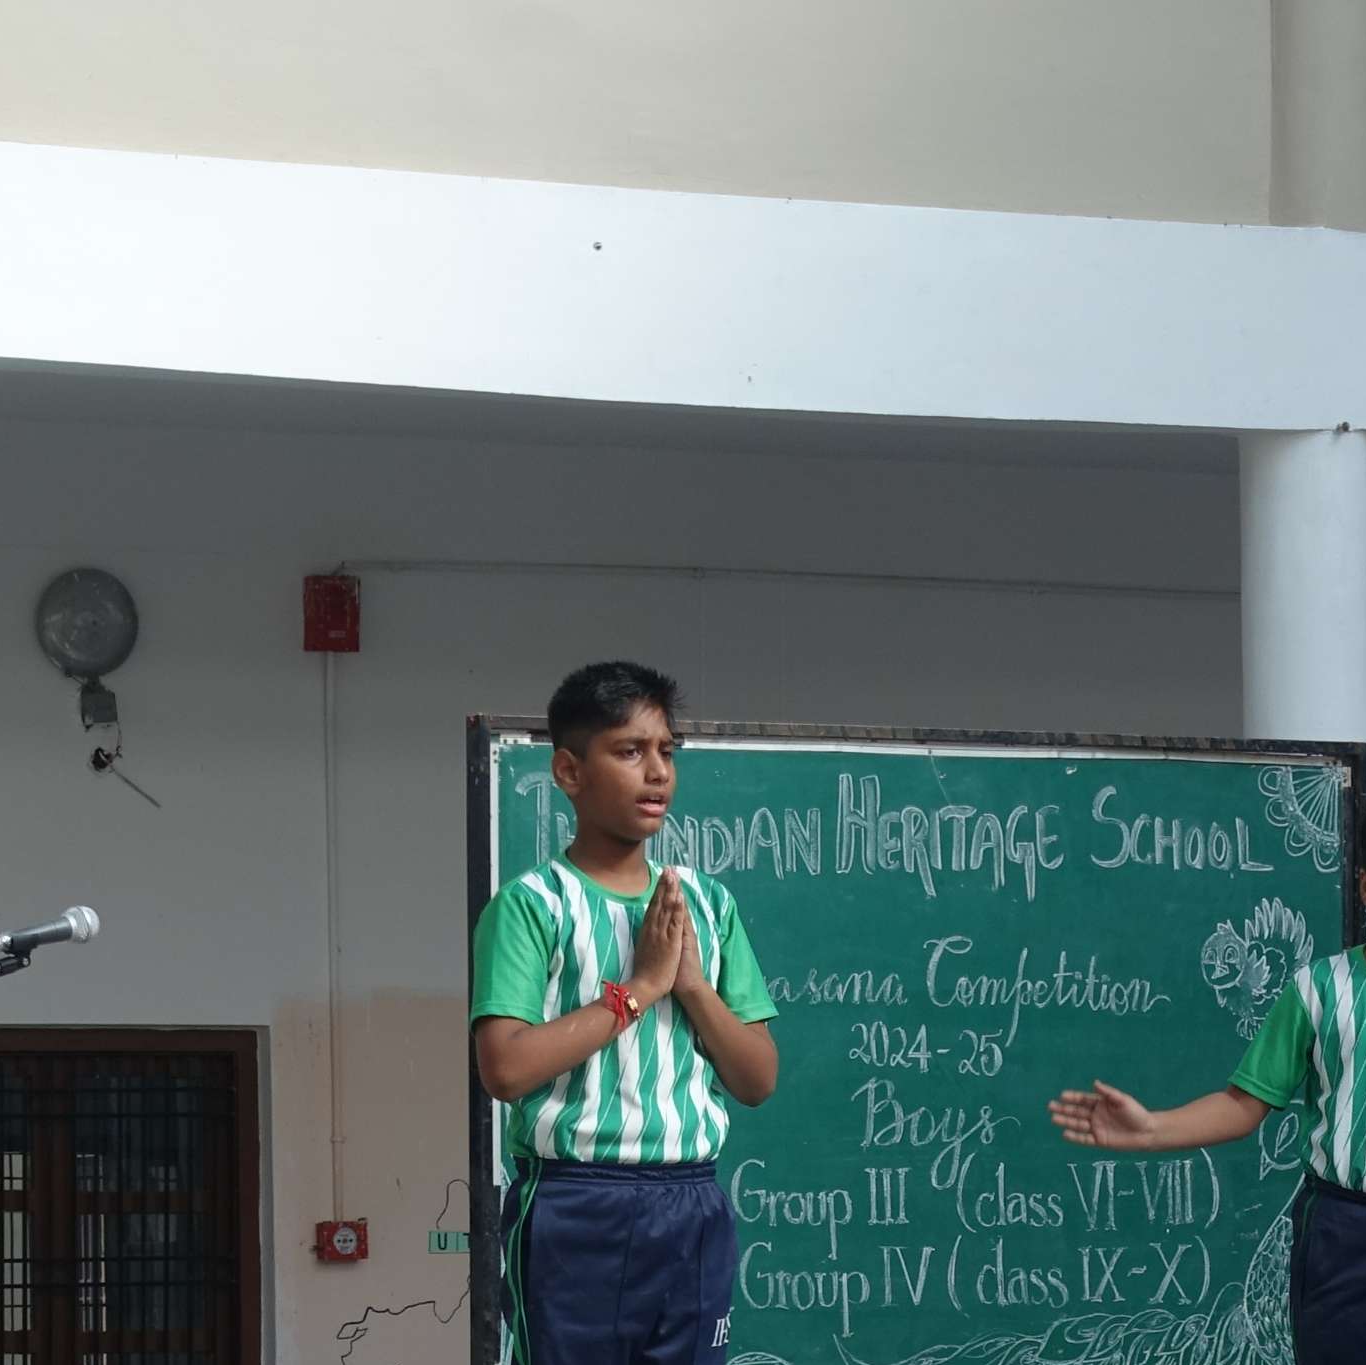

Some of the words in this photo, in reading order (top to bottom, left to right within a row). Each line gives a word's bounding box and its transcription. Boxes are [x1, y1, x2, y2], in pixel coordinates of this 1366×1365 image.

[766, 967, 907, 1005] asana
[923, 935, 1172, 1047] Competition
[851, 1077, 1021, 1190] Boys
[731, 1159, 852, 1260] Group
[864, 1167, 911, 1225] III
[739, 1241, 870, 1337] Group
[879, 1246, 935, 1306] IV
